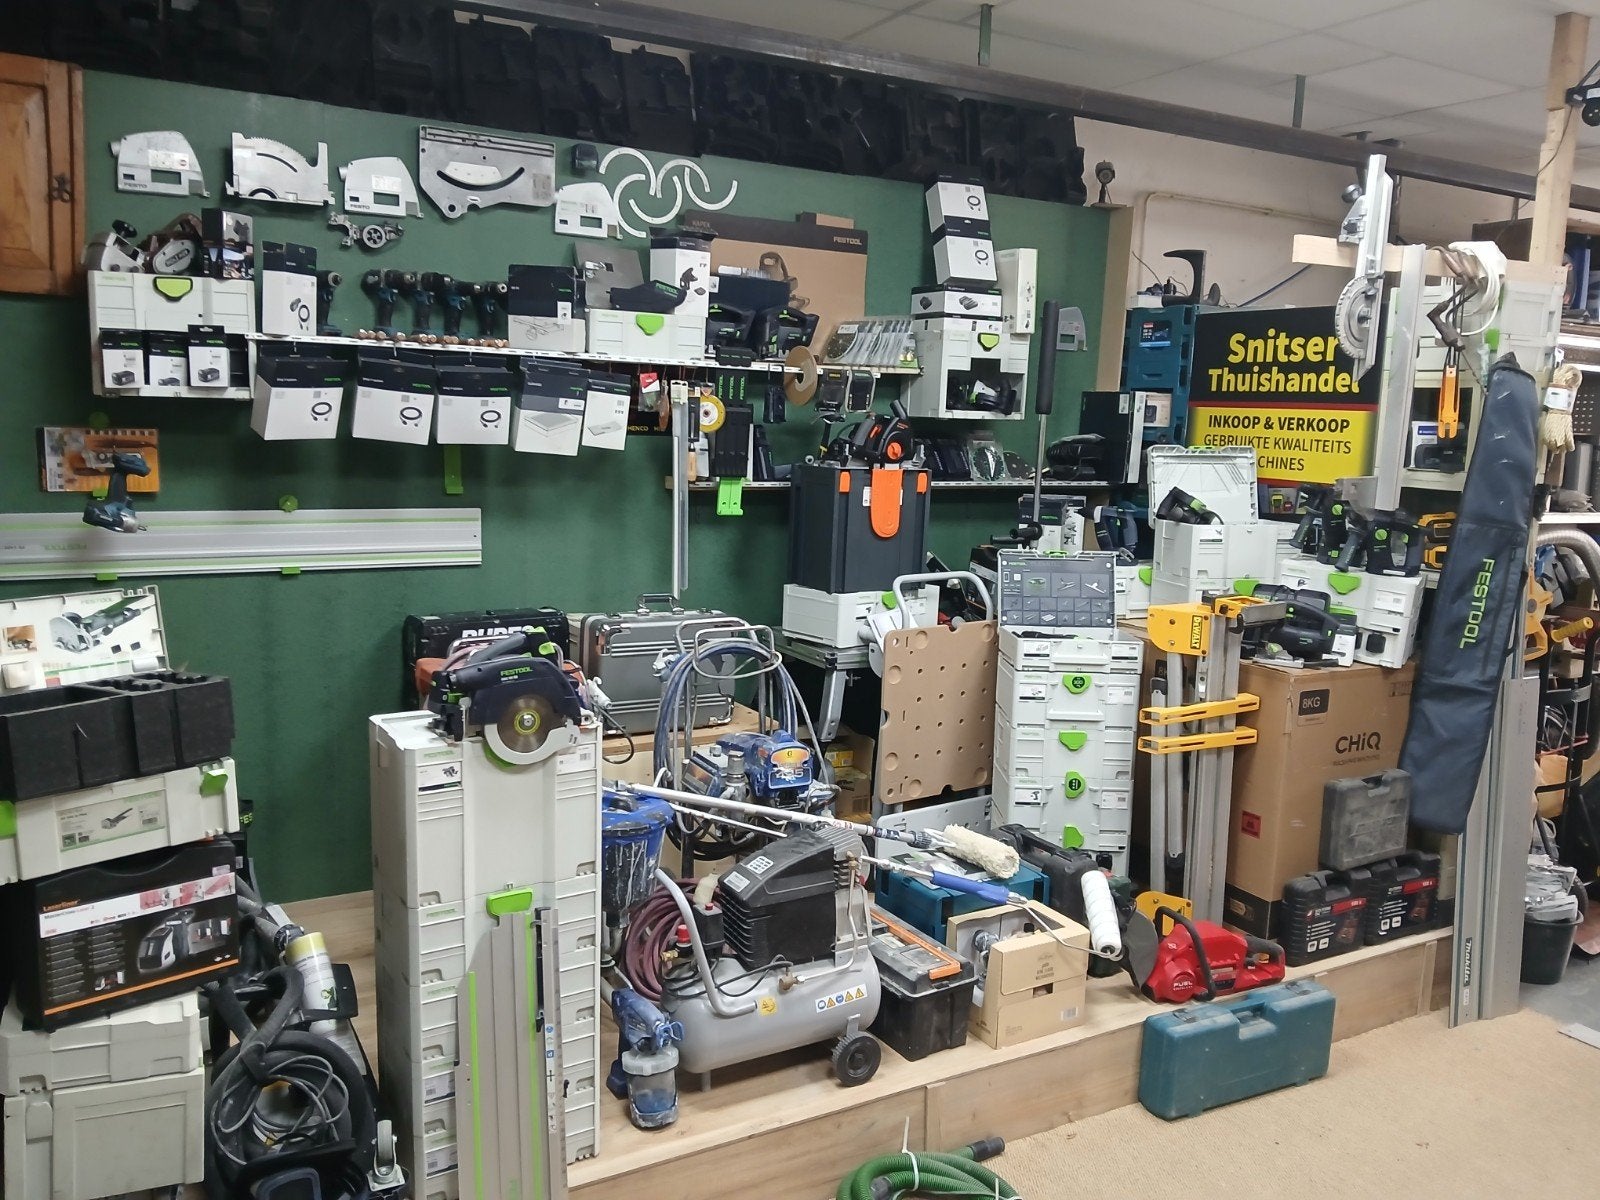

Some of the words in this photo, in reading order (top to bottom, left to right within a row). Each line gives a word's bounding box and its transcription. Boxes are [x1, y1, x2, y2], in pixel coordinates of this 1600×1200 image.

[349, 203, 371, 211] FESTO
[833, 236, 862, 246] FESTOOL
[655, 283, 679, 295] FESTOOL
[1228, 328, 1339, 364] Snitser
[1208, 415, 1261, 430] INKOOP
[1263, 416, 1274, 431] &
[1277, 417, 1350, 434] VERKOOP
[1204, 434, 1270, 449] GEBRUIKTE
[1274, 437, 1352, 454] KWALITEITS
[1257, 456, 1305, 471] CHINES
[1458, 558, 1496, 649] FESTOOL
[501, 667, 533, 676] FESTOOL
[1302, 696, 1321, 709] 8KG
[1335, 731, 1381, 754] CHiQ
[43, 899, 80, 912] Laserliner
